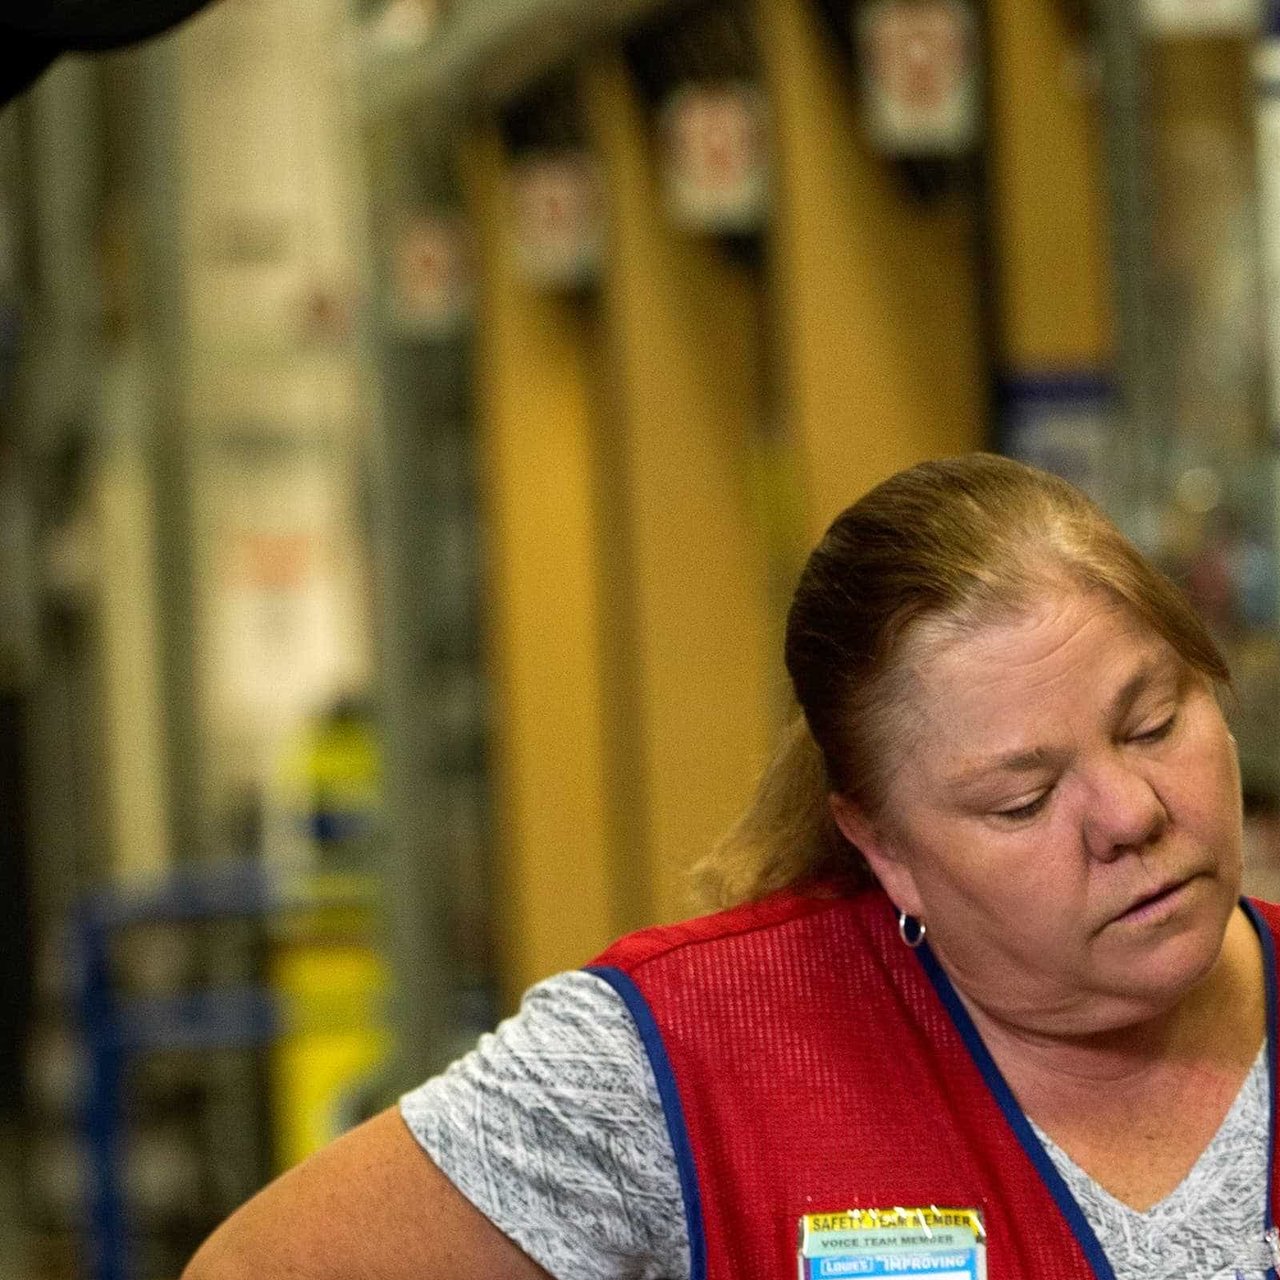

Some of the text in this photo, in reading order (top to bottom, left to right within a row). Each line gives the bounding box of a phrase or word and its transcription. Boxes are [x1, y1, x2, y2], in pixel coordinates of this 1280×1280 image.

[813, 1213, 972, 1232] SAFETY TEAM MEMBER
[821, 1234, 954, 1249] VOICE TEAM MEMBER
